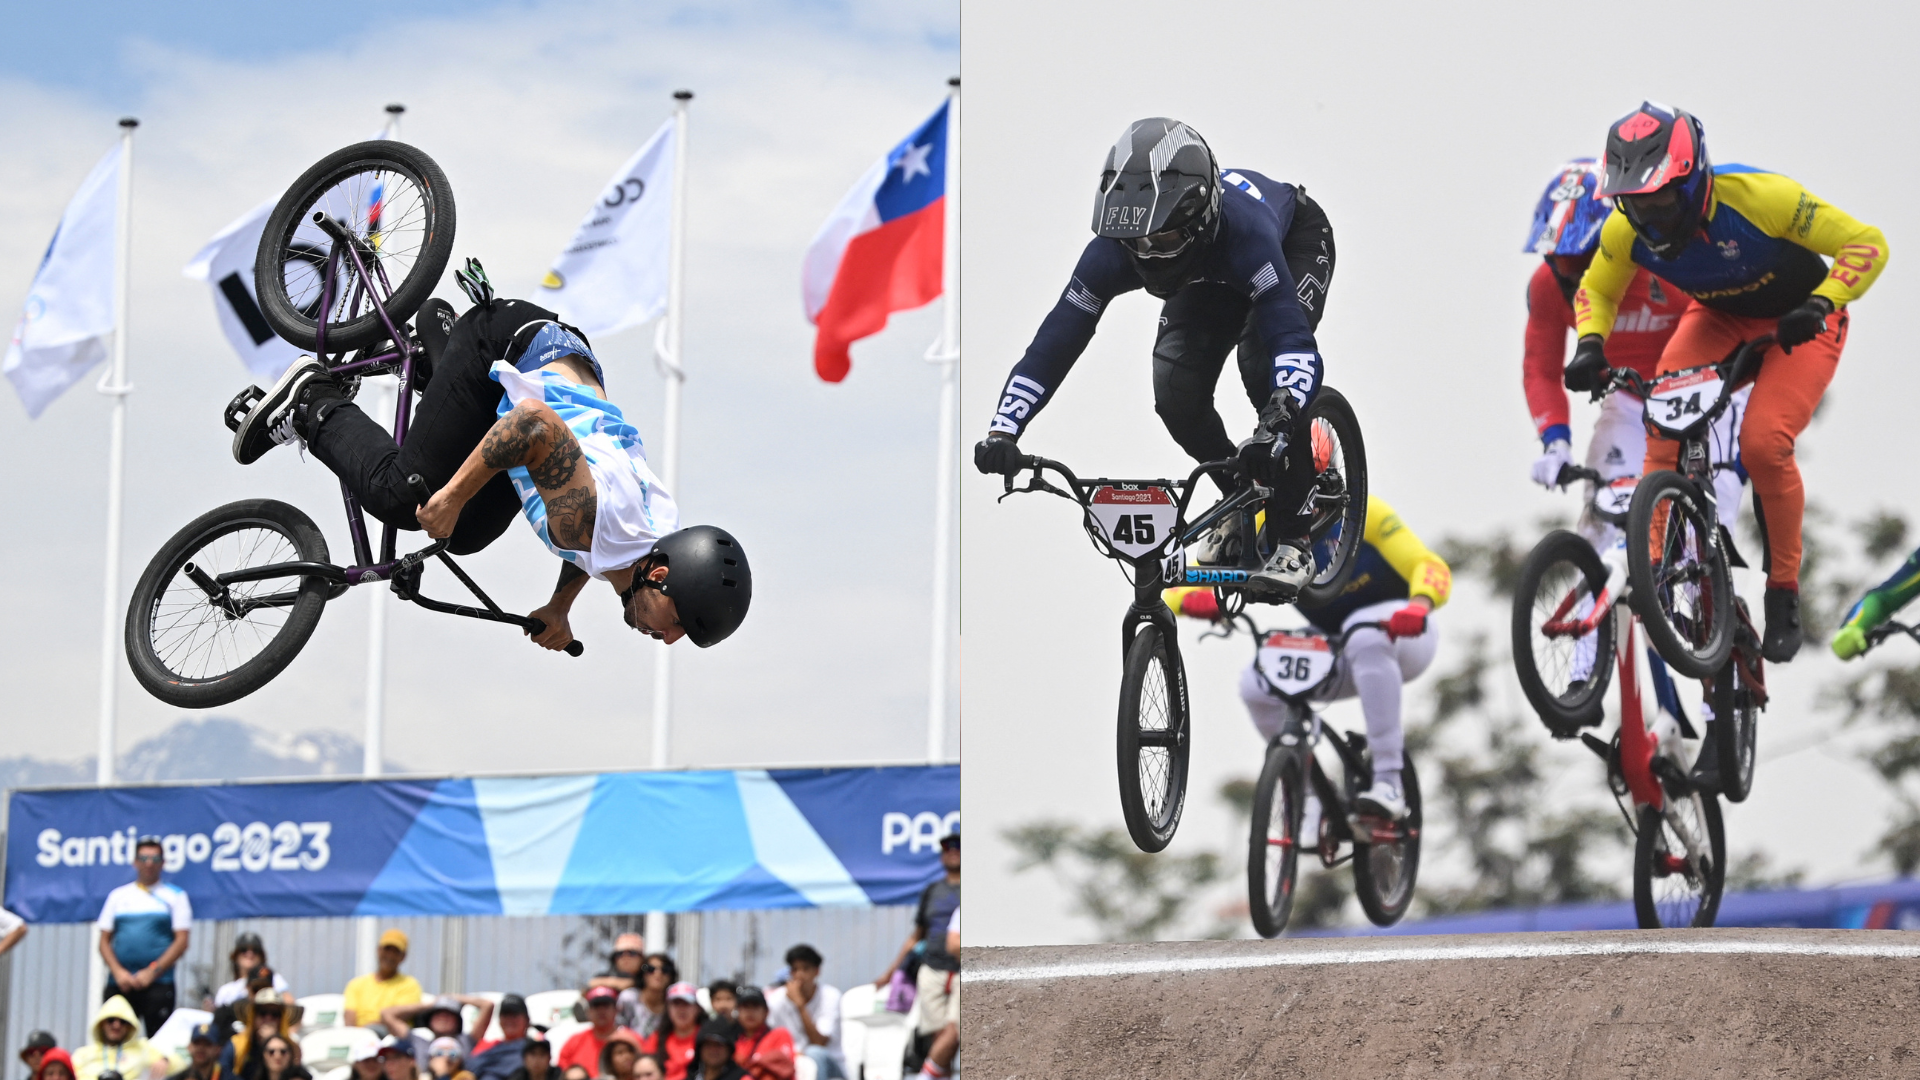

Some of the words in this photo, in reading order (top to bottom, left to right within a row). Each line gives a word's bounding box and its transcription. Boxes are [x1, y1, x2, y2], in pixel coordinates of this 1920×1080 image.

[1105, 205, 1147, 225] FLY
[1829, 243, 1880, 289] ECU
[989, 374, 1046, 436] USA
[1665, 391, 1702, 422] 34
[1111, 492, 1135, 502] Santiago
[1135, 493, 1152, 503] 2023
[1121, 481, 1139, 491] box
[1112, 513, 1156, 545] 45
[1164, 553, 1179, 581] 45
[1277, 655, 1311, 682] 36
